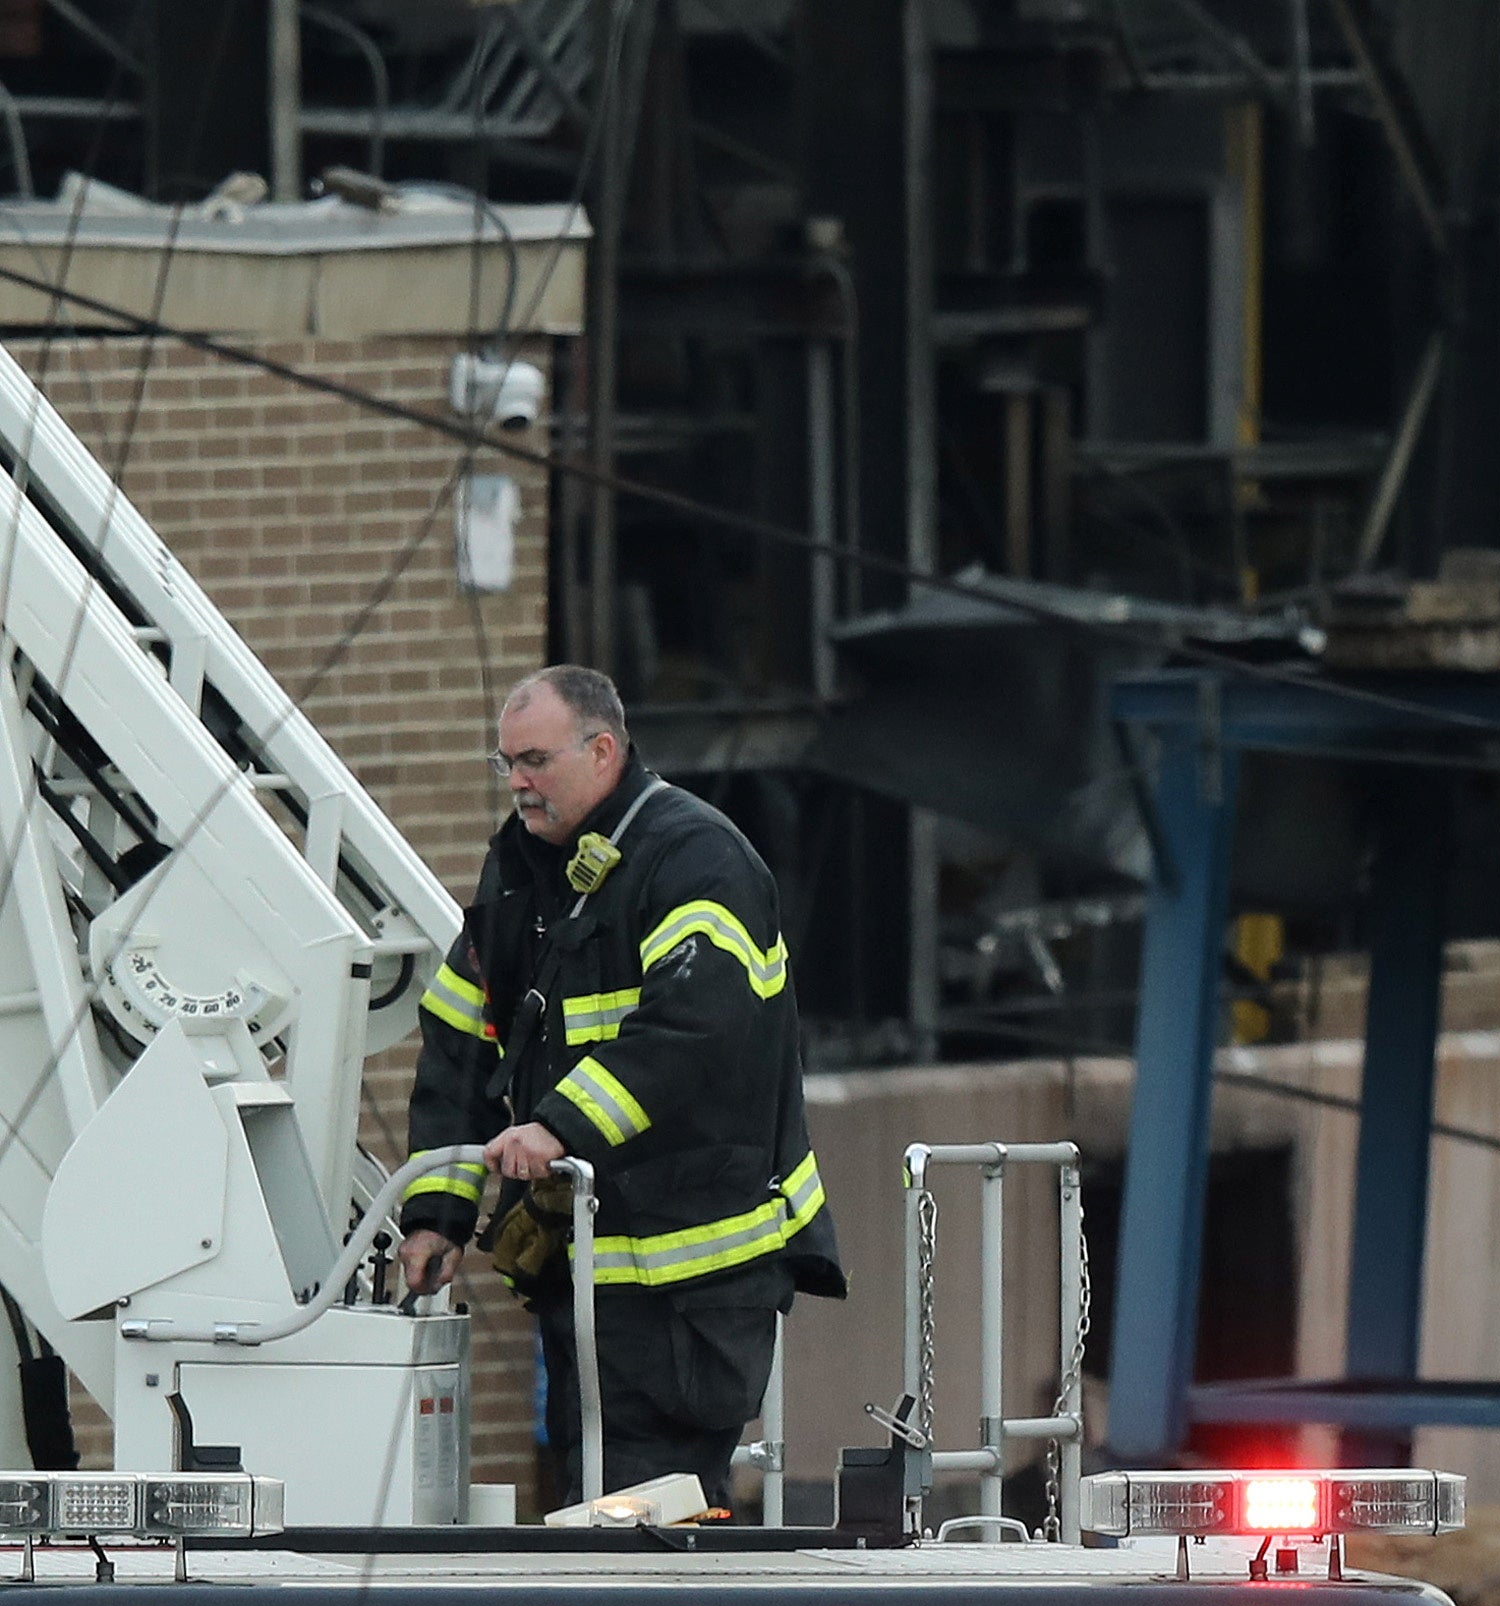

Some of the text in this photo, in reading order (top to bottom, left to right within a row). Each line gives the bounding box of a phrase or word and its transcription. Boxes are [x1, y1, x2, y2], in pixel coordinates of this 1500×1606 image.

[159, 992, 178, 1007] 20
[181, 1003, 198, 1014] 40
[203, 1003, 220, 1014] 60
